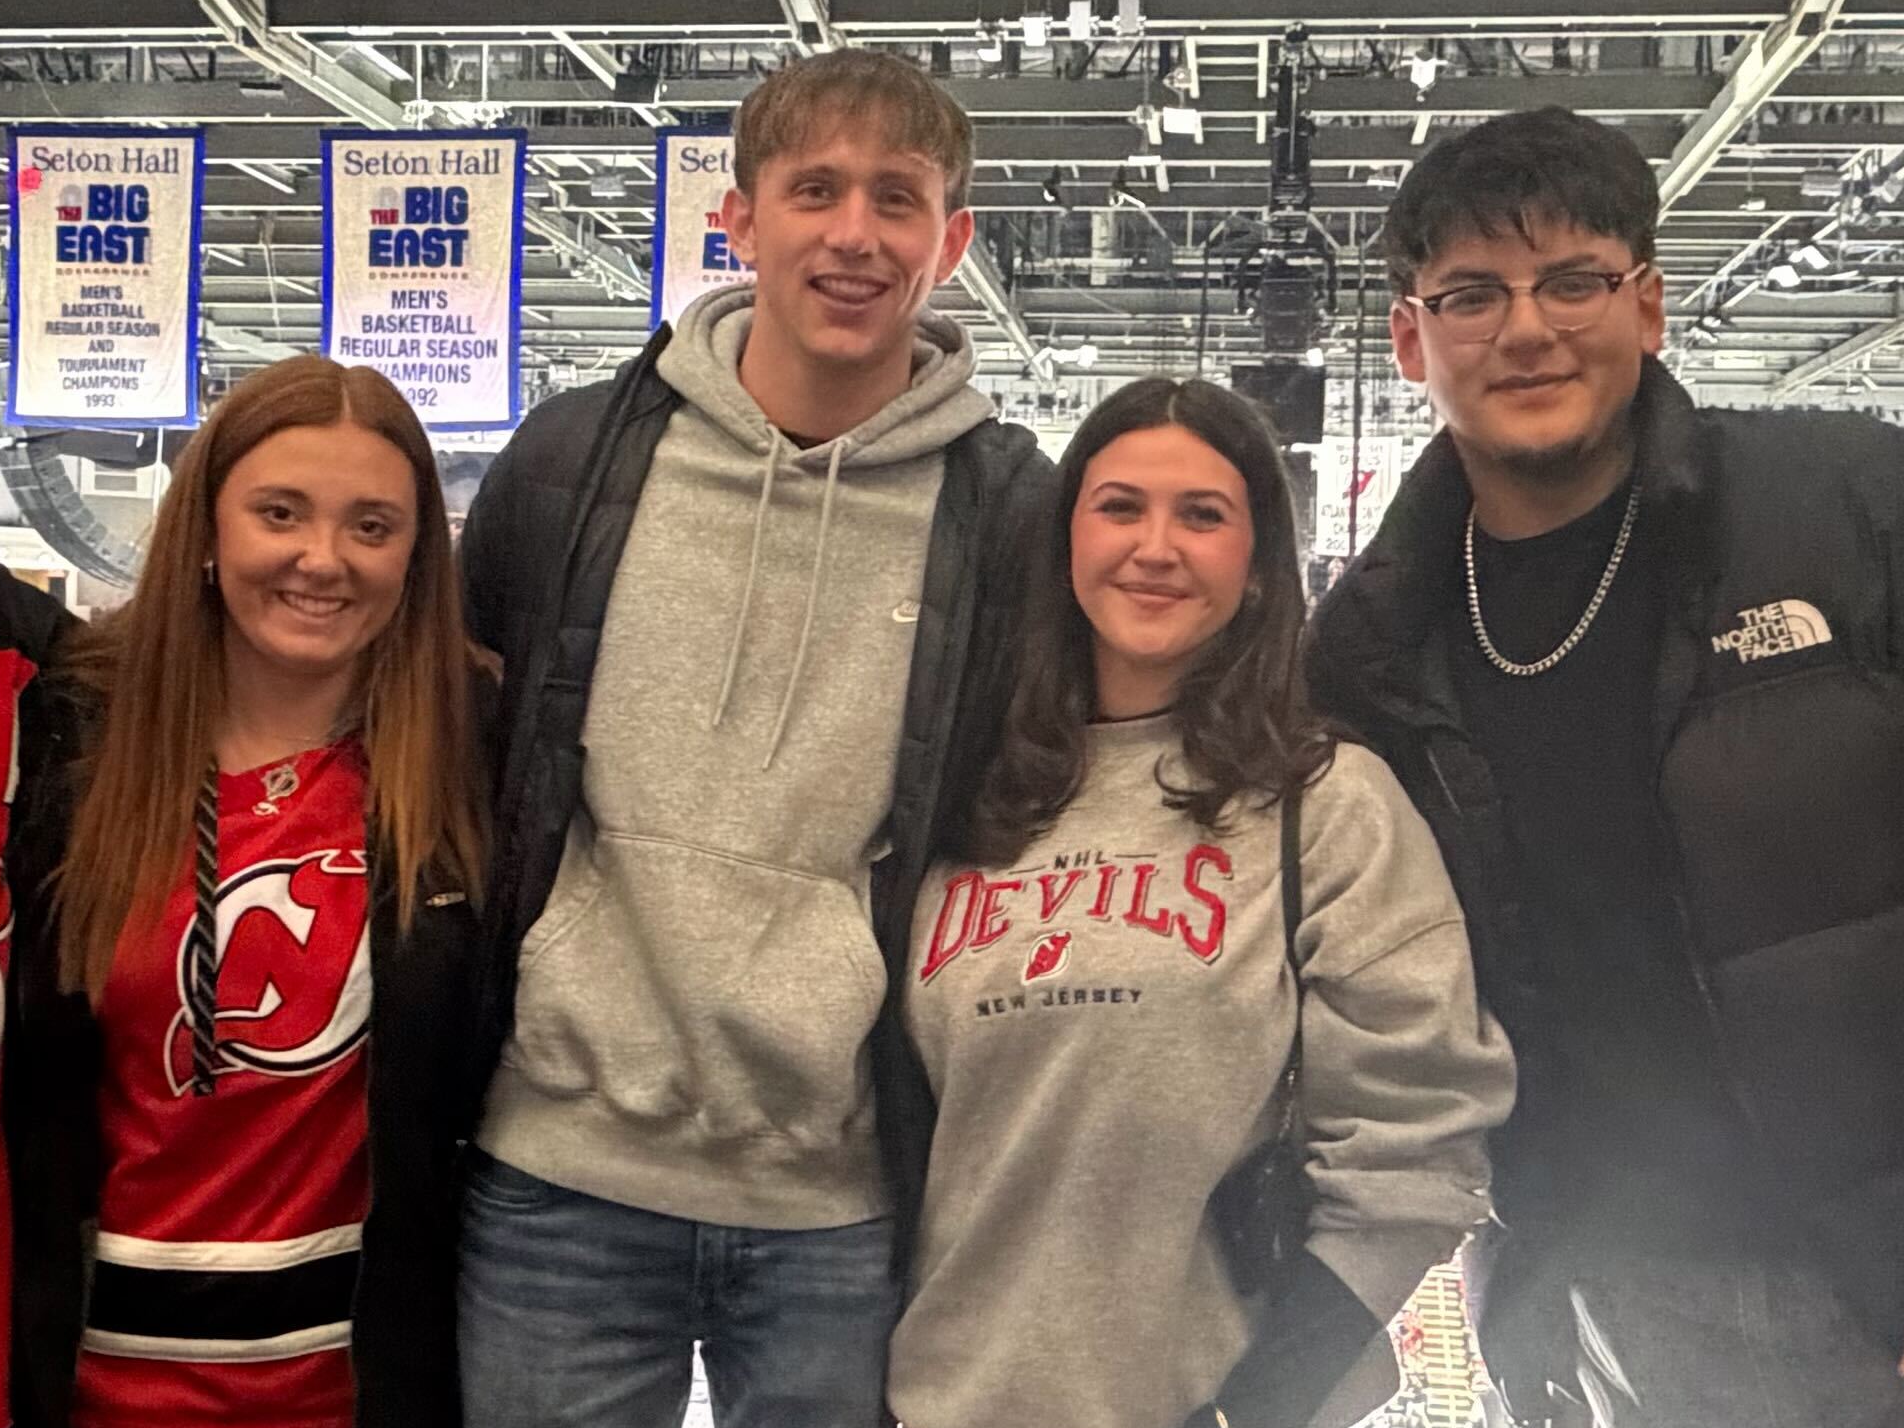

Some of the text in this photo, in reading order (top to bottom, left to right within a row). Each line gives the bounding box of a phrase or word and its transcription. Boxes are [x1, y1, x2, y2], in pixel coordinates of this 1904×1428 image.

[32, 146, 180, 174] Seton Hall
[344, 148, 501, 176] Seton Hall
[680, 146, 734, 174] Set
[88, 184, 150, 223] BIG
[370, 186, 469, 225] THE BIG
[56, 225, 150, 264] EAST
[368, 228, 469, 268] EAST
[80, 285, 123, 300] MEN'S
[391, 290, 448, 310] MEN'S
[61, 303, 145, 319] BASKETBALL
[108, 322, 161, 337] SEASON
[361, 315, 477, 335] BASKETBALL
[88, 339, 115, 353] AND
[339, 336, 498, 359] REGULAR SEASON
[58, 358, 146, 373] TOURNAMENT
[378, 363, 471, 384] AMPIONS
[62, 376, 139, 390] CHAMPIONS
[1737, 603, 1783, 626] THE
[1711, 620, 1788, 653] NORTH
[1739, 635, 1796, 664] FACE
[1054, 850, 1107, 870] NHL
[920, 843, 1233, 986] DEVILS
[976, 987, 1143, 1017] NEW JERSEY
